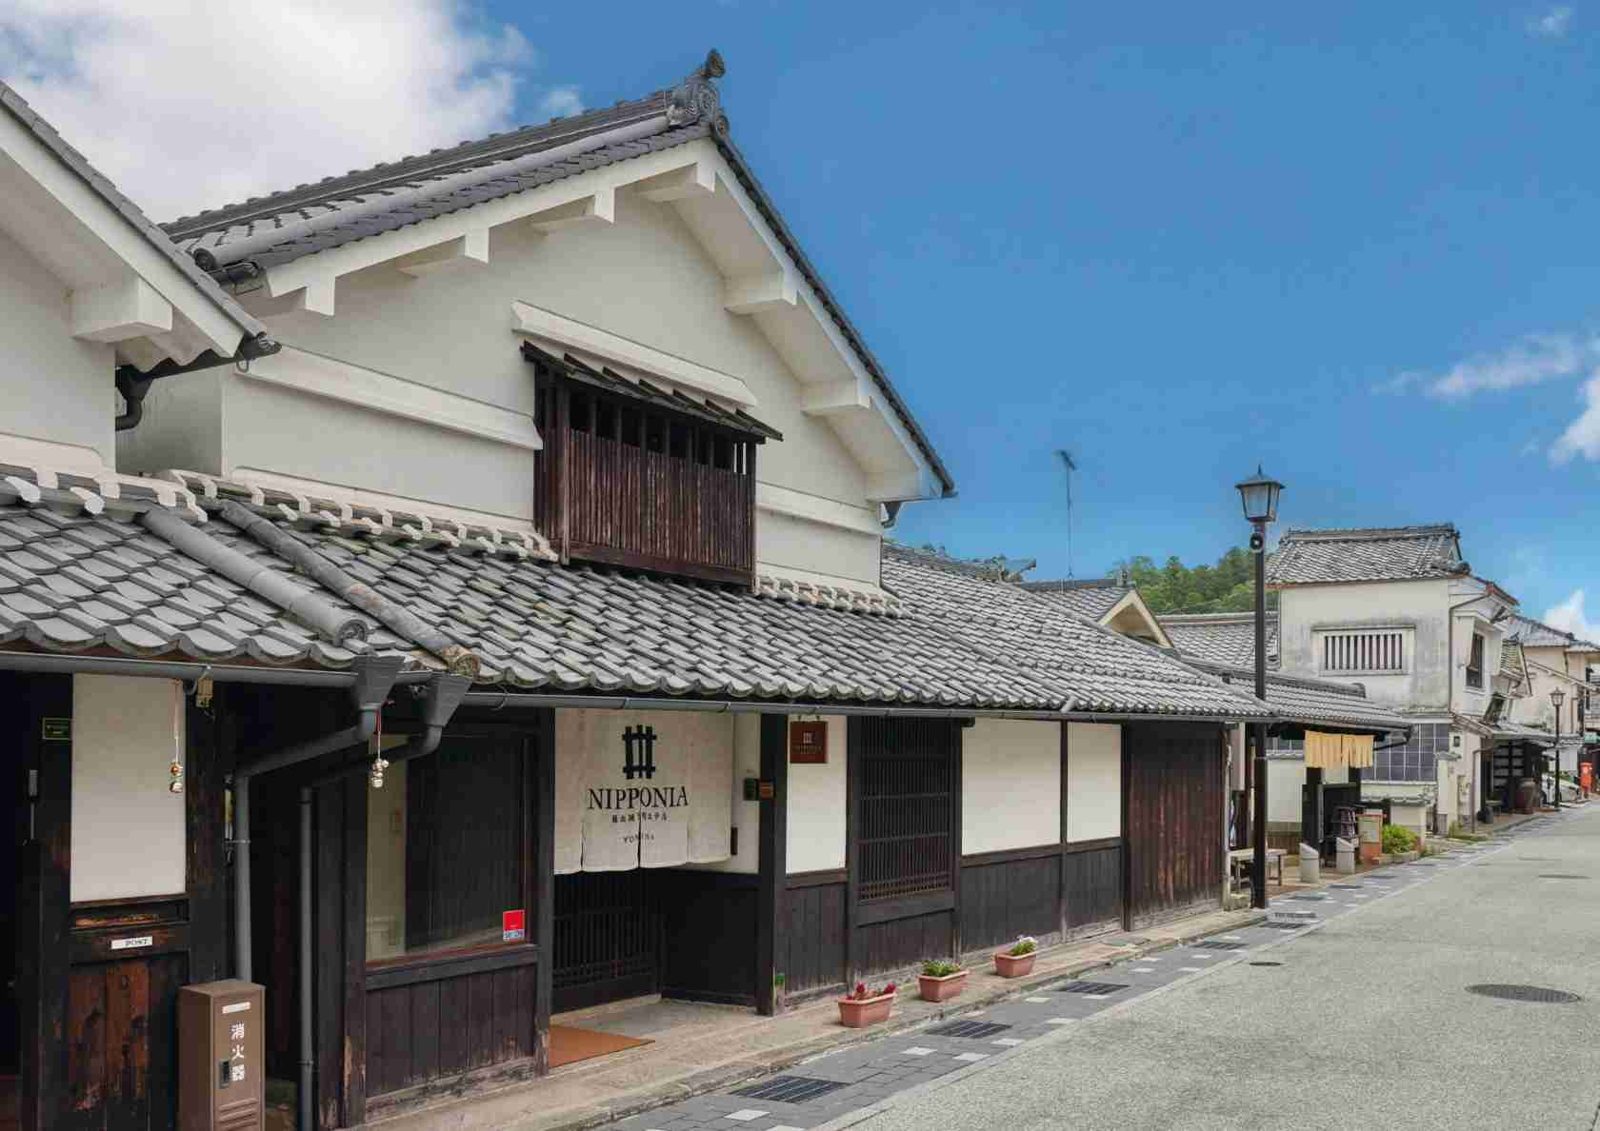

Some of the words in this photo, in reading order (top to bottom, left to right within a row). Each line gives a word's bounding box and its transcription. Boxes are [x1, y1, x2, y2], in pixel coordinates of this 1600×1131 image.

[587, 786, 688, 809] NIPPONIA
[231, 1023, 245, 1081] 消火器
